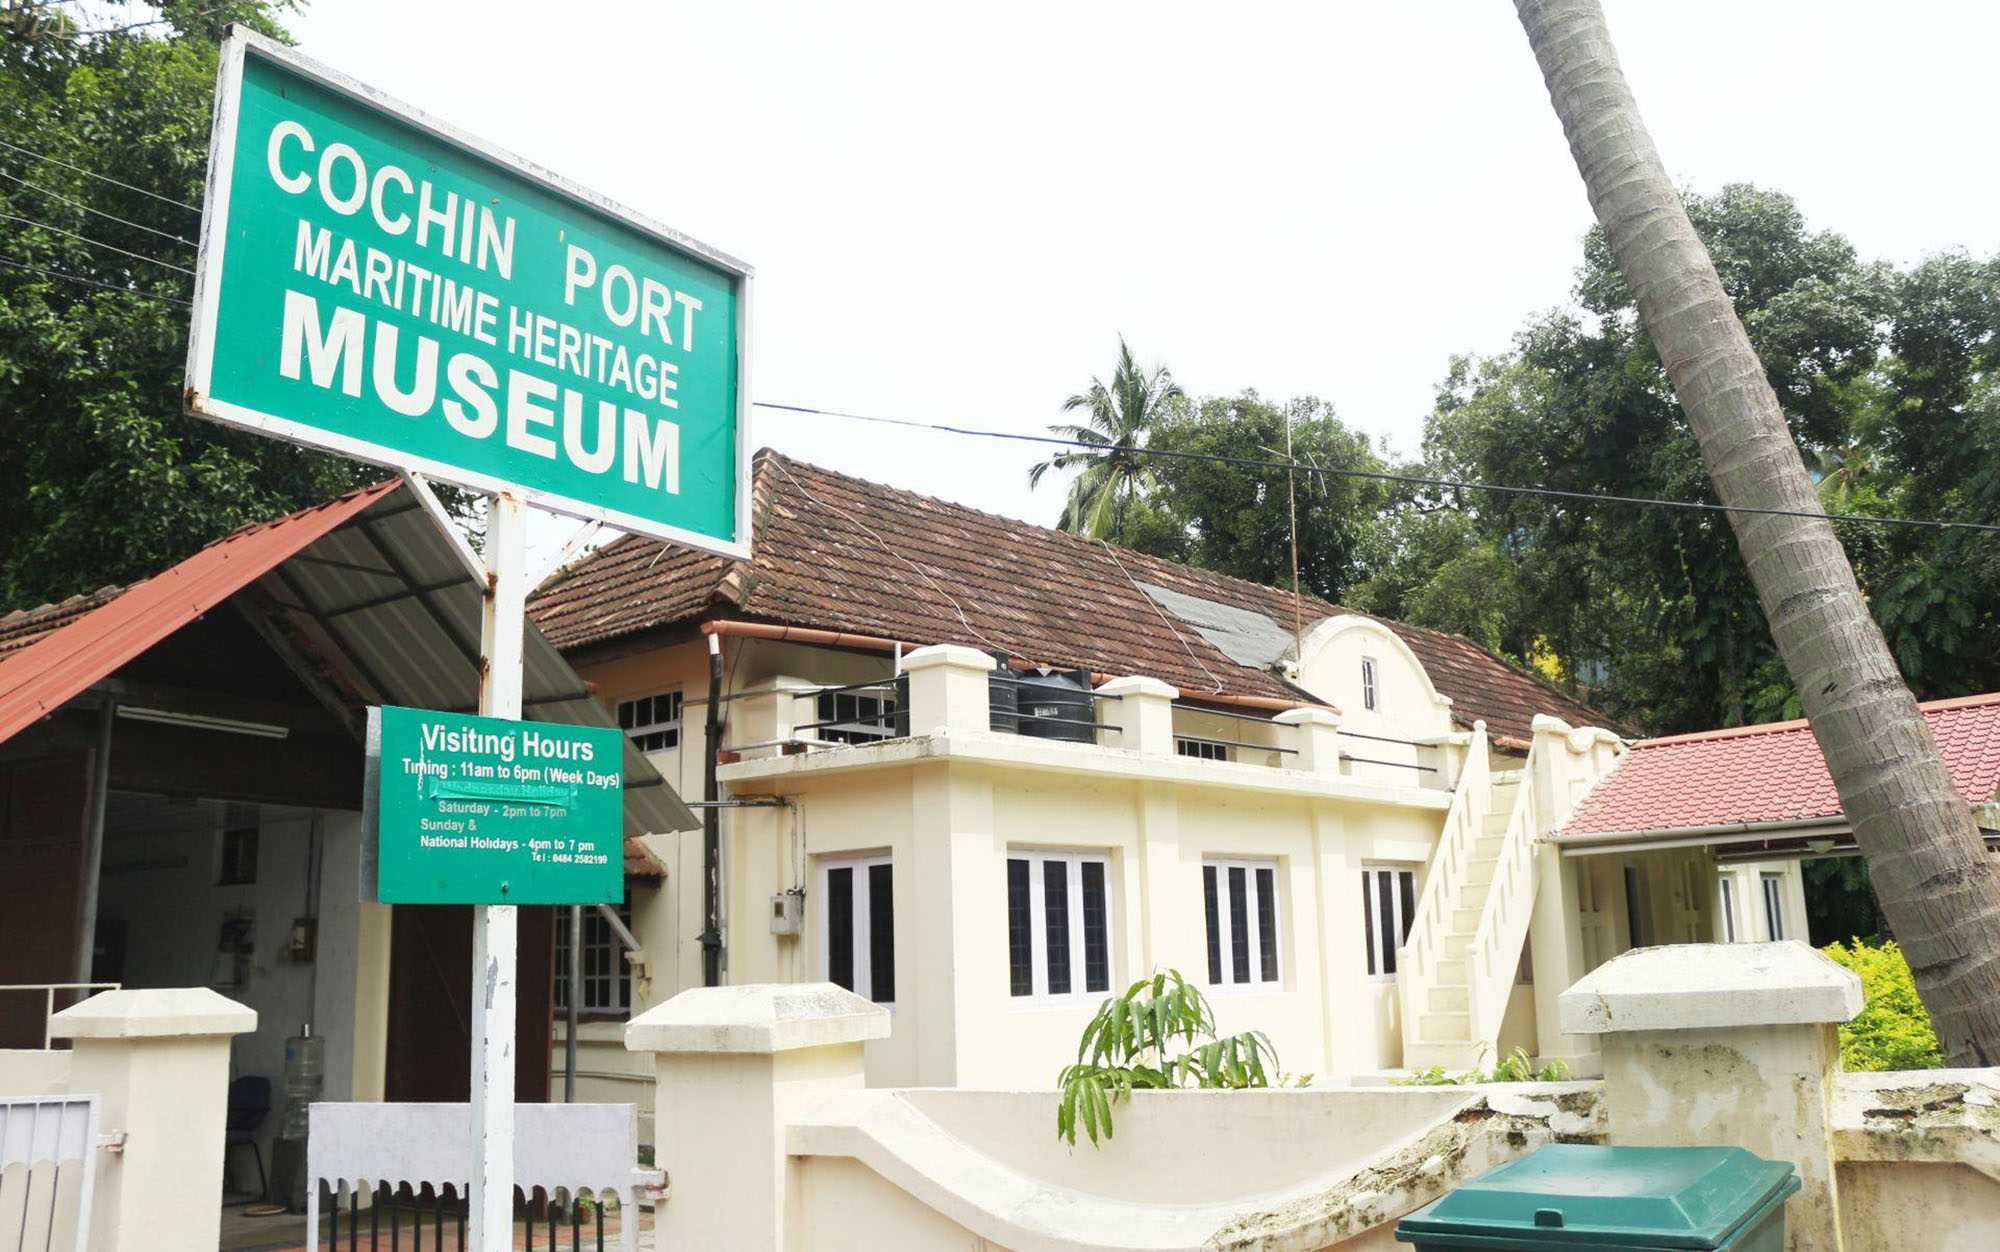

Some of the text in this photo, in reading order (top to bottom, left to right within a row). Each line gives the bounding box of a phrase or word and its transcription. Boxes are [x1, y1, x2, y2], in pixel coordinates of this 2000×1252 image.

[267, 119, 703, 353] COCHIN PORT
[293, 218, 679, 410] MARITIME HERITAGE
[279, 288, 681, 496] MUSEUM
[421, 723, 594, 762] Visiting Hours
[402, 757, 448, 779] Timing
[460, 761, 494, 778] 11am
[497, 764, 510, 778] to
[513, 764, 541, 783] 6pm
[544, 767, 583, 785] (Week
[586, 771, 620, 789] Days)
[420, 818, 477, 833] Sunday &
[438, 801, 490, 817] Saturday
[502, 805, 527, 819] 2pm
[529, 806, 541, 817] to
[543, 805, 567, 819] 7pm
[420, 835, 468, 849] National
[470, 837, 519, 852] Holidays
[528, 838, 552, 852] 4pm
[554, 839, 565, 850] to
[568, 839, 575, 851] 7
[578, 842, 595, 853] pm
